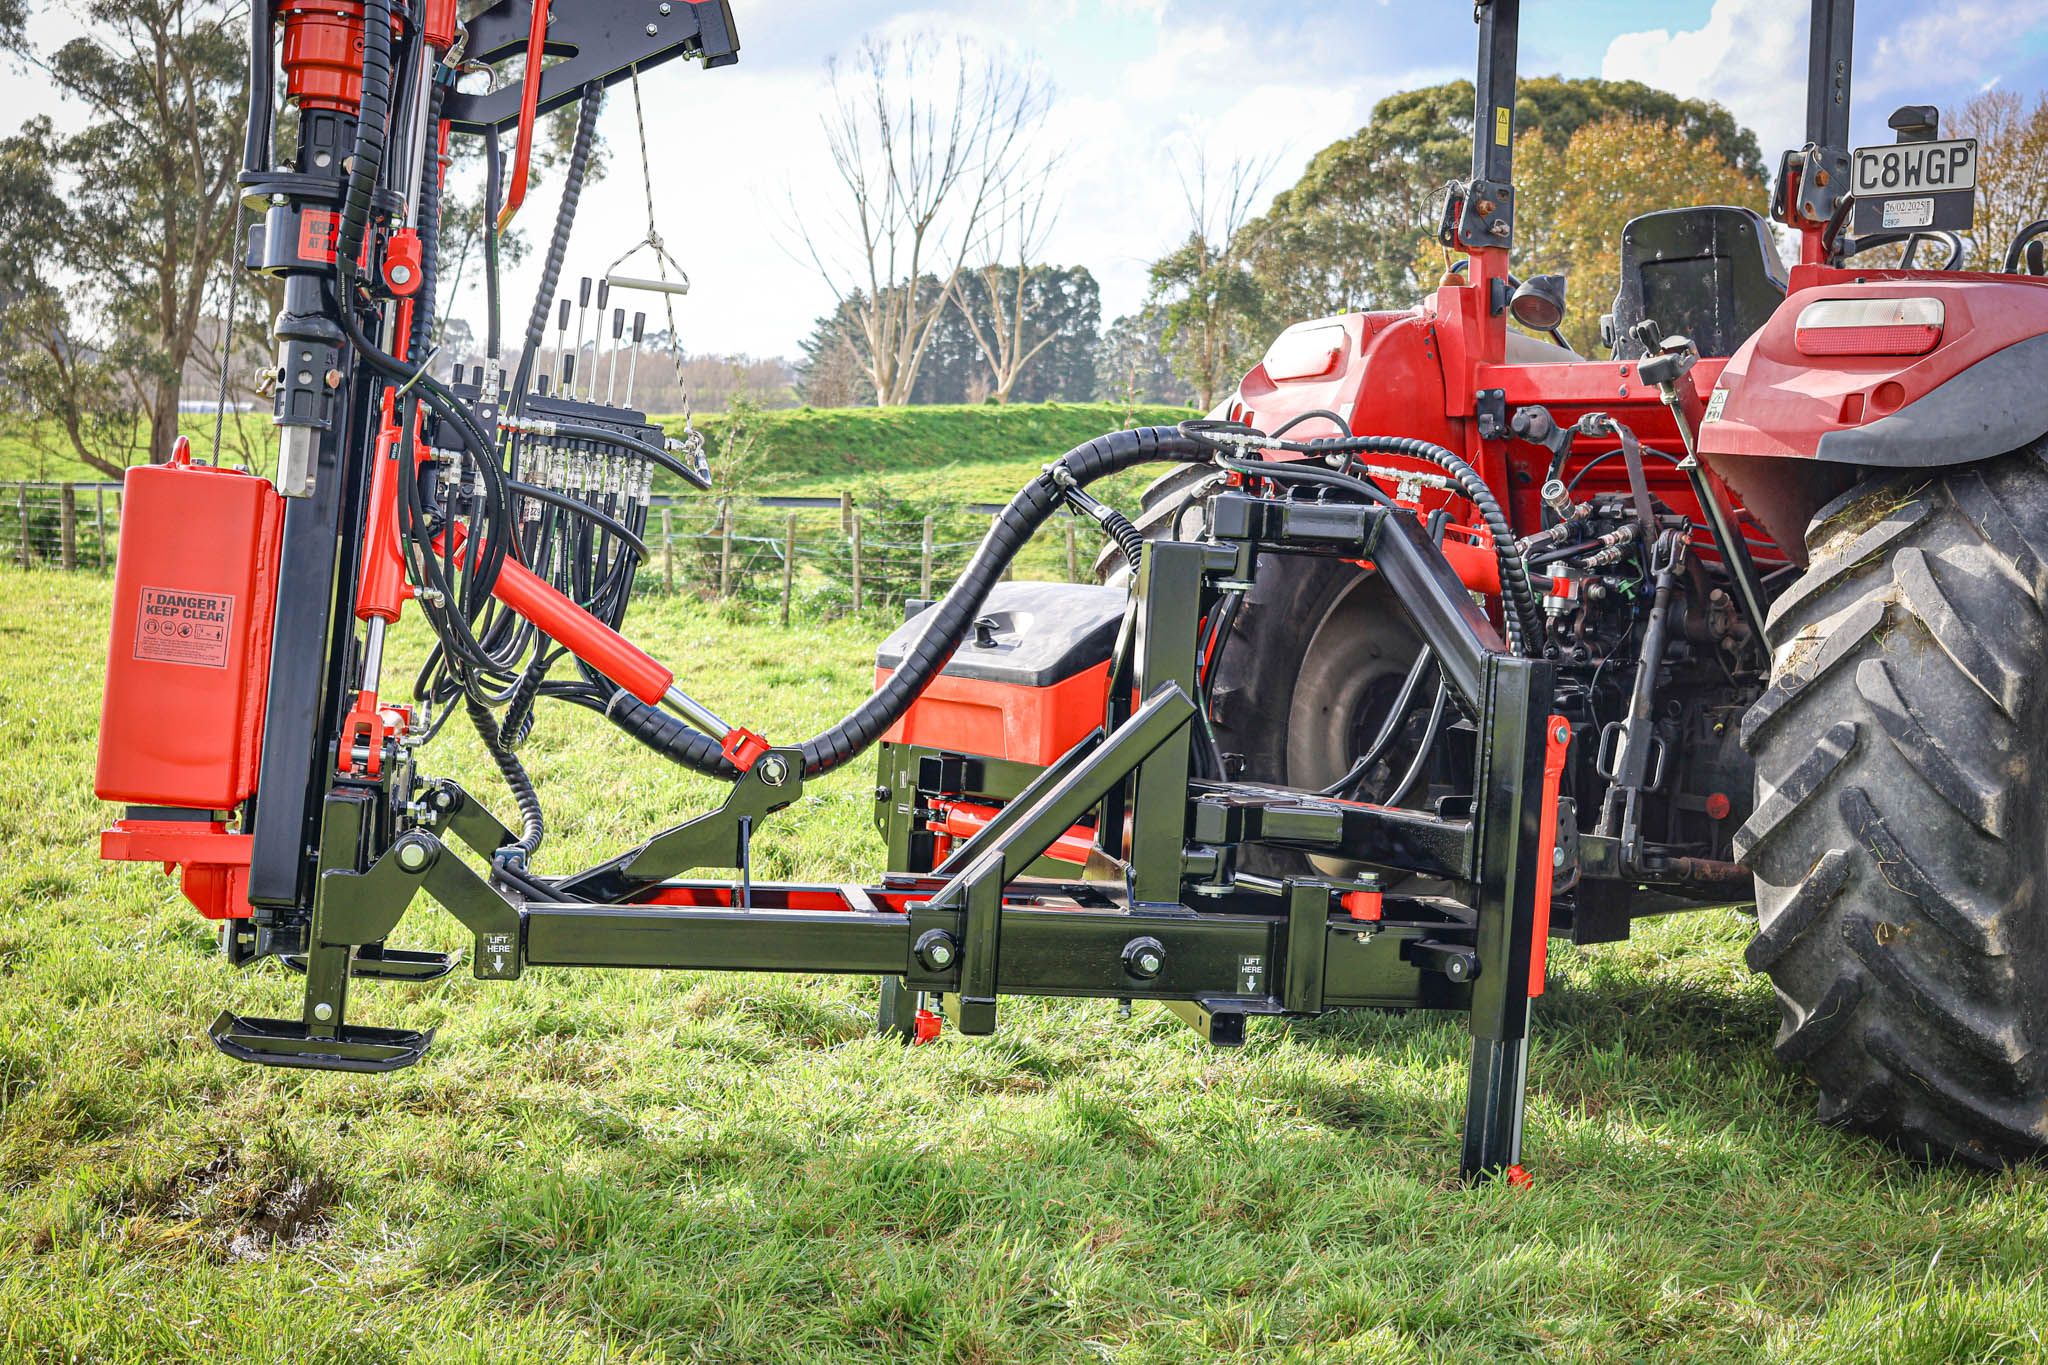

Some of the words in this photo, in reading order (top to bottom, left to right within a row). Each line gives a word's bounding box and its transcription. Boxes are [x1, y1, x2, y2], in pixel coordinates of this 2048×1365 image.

[1859, 147, 1970, 190] C8WGP
[309, 221, 335, 235] KEEP
[308, 237, 320, 249] AT
[157, 594, 217, 611] DANGER
[145, 604, 180, 617] KEEP
[182, 608, 225, 622] CLEAR
[489, 935, 508, 944] LIFT
[487, 944, 511, 953] HERE
[1244, 957, 1261, 966] LIFT
[1241, 965, 1263, 974] HERE
